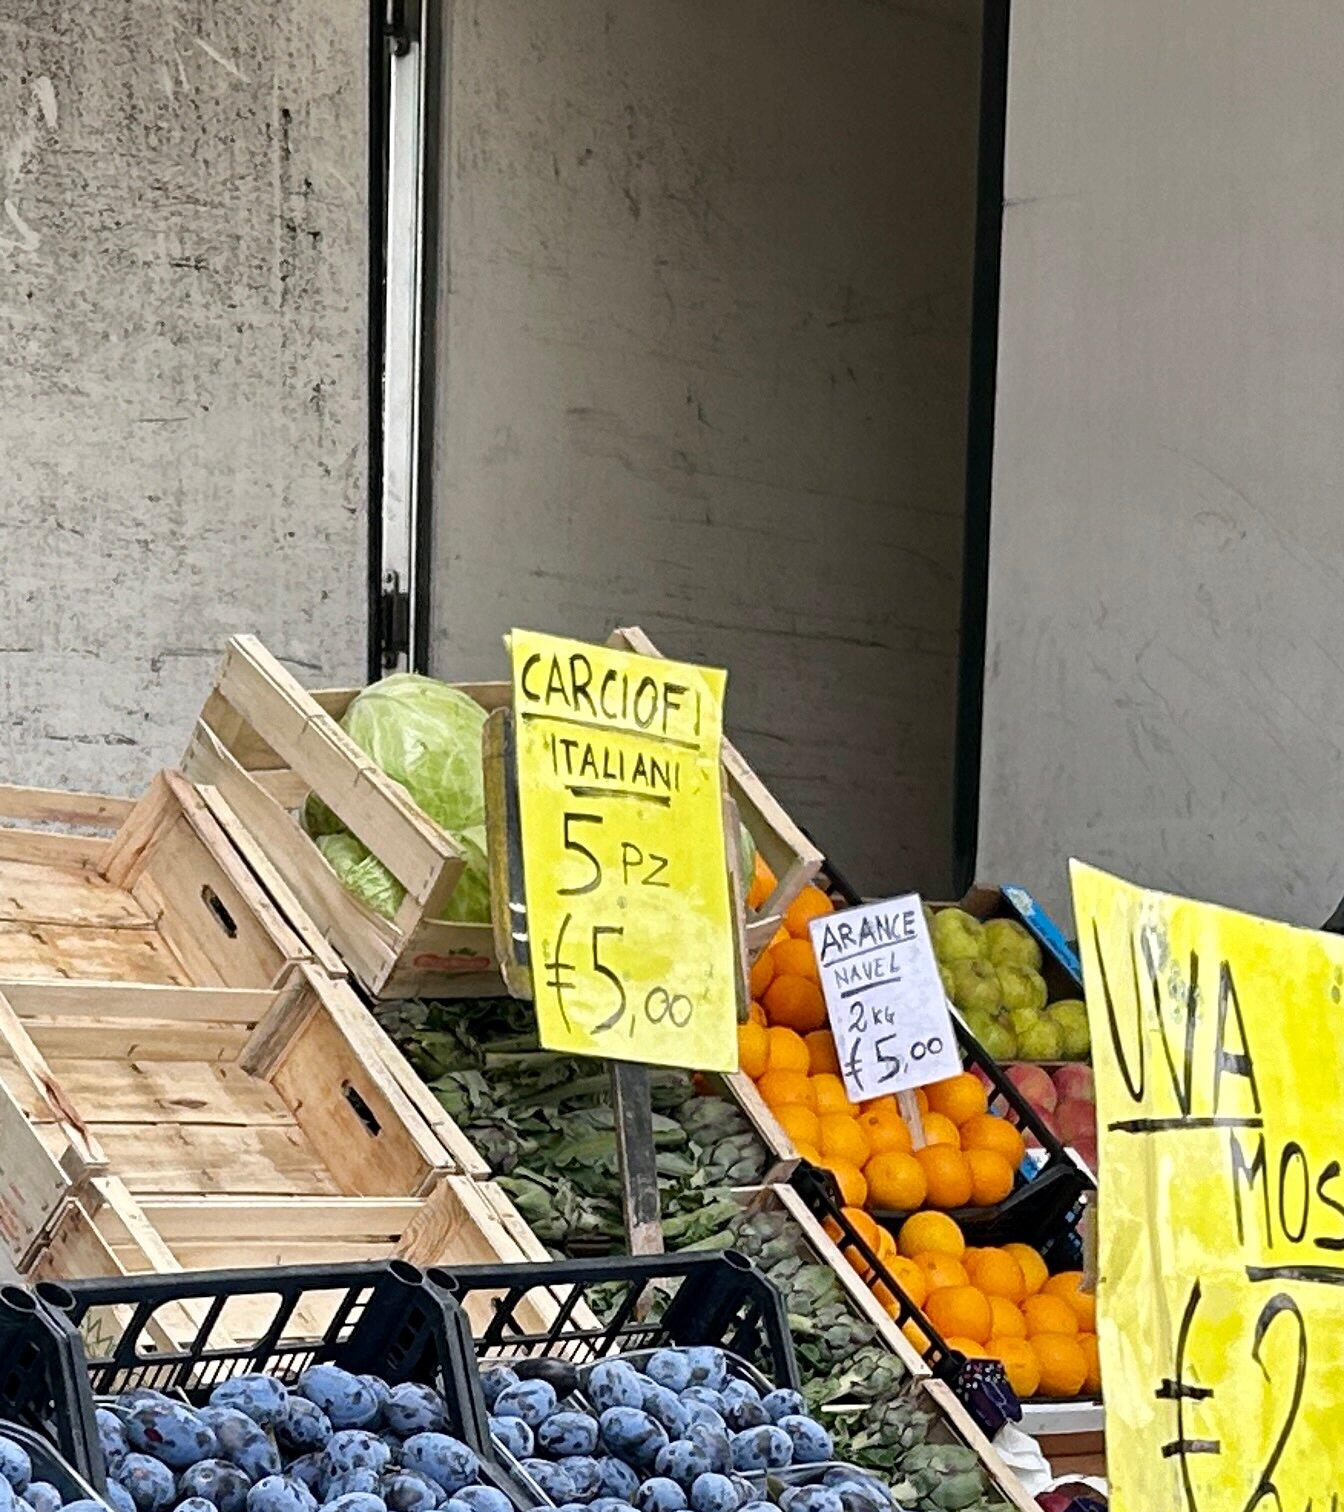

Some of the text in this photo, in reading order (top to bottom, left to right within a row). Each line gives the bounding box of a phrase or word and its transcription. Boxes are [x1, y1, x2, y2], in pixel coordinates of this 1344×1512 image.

[520, 652, 702, 737] CARCIOFI
[551, 734, 681, 792] ITALIANI
[557, 812, 671, 896] 5 PZ
[821, 910, 916, 961] ARANCE
[835, 951, 901, 988] NAVEL
[543, 912, 694, 1040] €5,00
[1093, 917, 1261, 1119] UVA
[844, 1033, 943, 1092] €5,00
